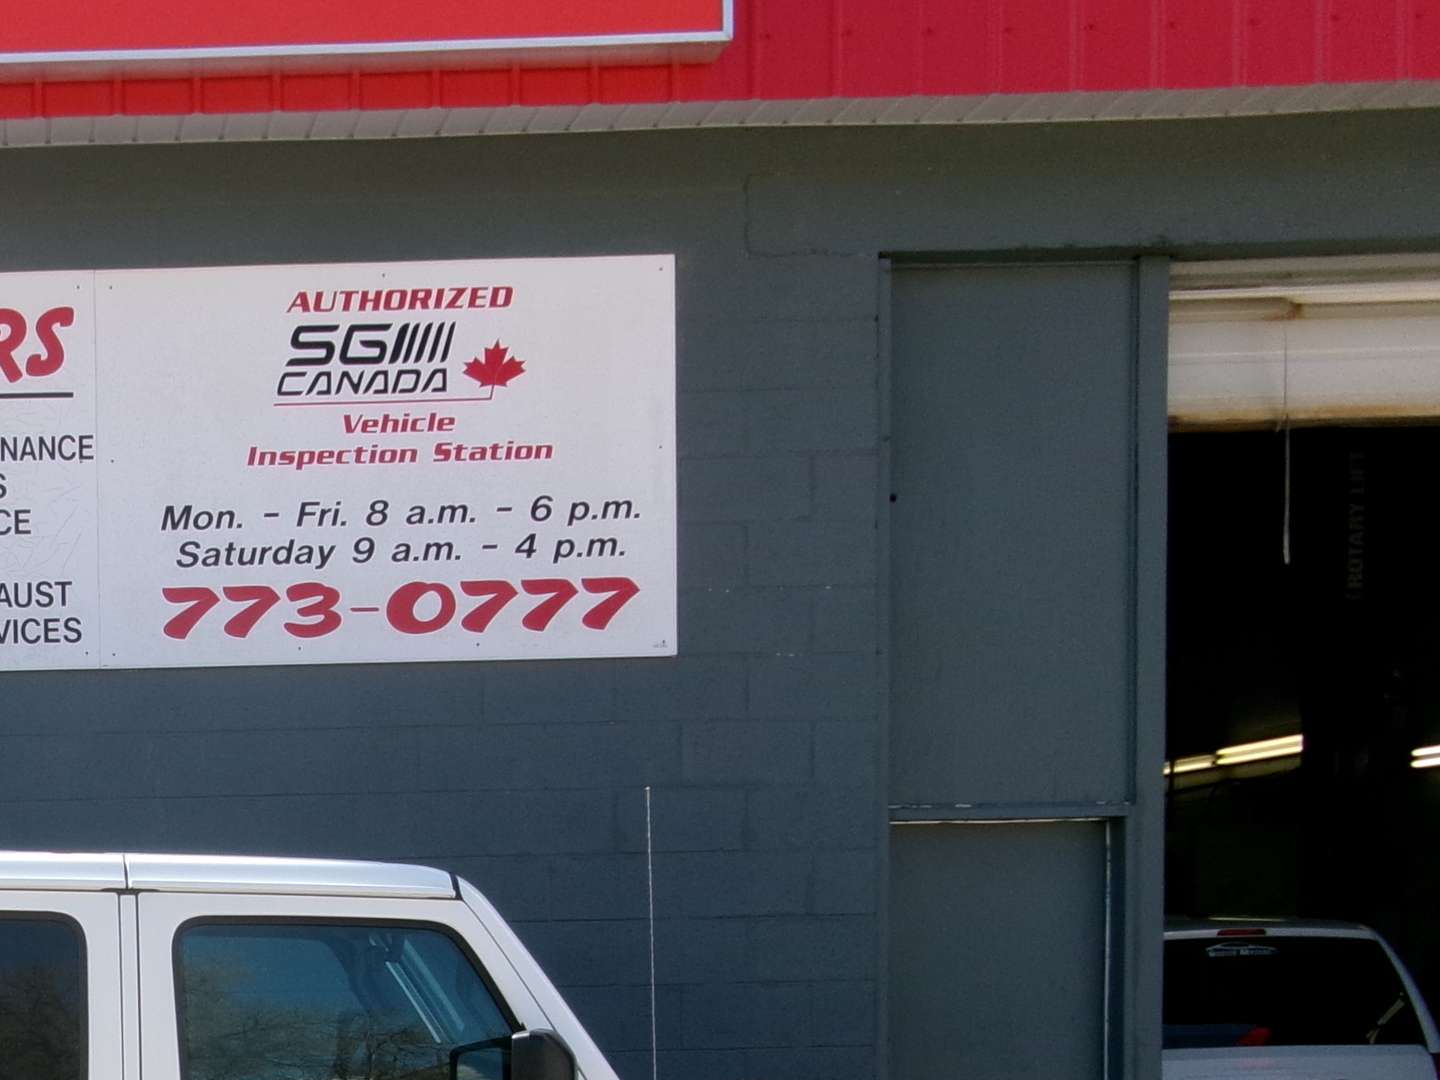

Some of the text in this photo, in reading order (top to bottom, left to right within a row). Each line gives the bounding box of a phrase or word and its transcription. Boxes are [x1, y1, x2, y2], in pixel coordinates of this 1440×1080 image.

[286, 286, 514, 313] AUTHORIZED
[276, 367, 448, 397] CANADA
[343, 411, 456, 435] Vehicle
[247, 442, 553, 471] Inspection Station
[160, 504, 243, 531] Mon.
[296, 500, 347, 527] Fri.
[365, 499, 390, 527] 8
[405, 504, 476, 525] a.m.
[530, 494, 554, 522] 6
[567, 499, 641, 527] p.m.
[175, 538, 337, 570] Saturday
[352, 536, 376, 564] 9
[391, 541, 461, 563] a.m.
[514, 533, 537, 559] 4
[552, 537, 625, 565] p.m.
[161, 576, 641, 640] 773-0777
